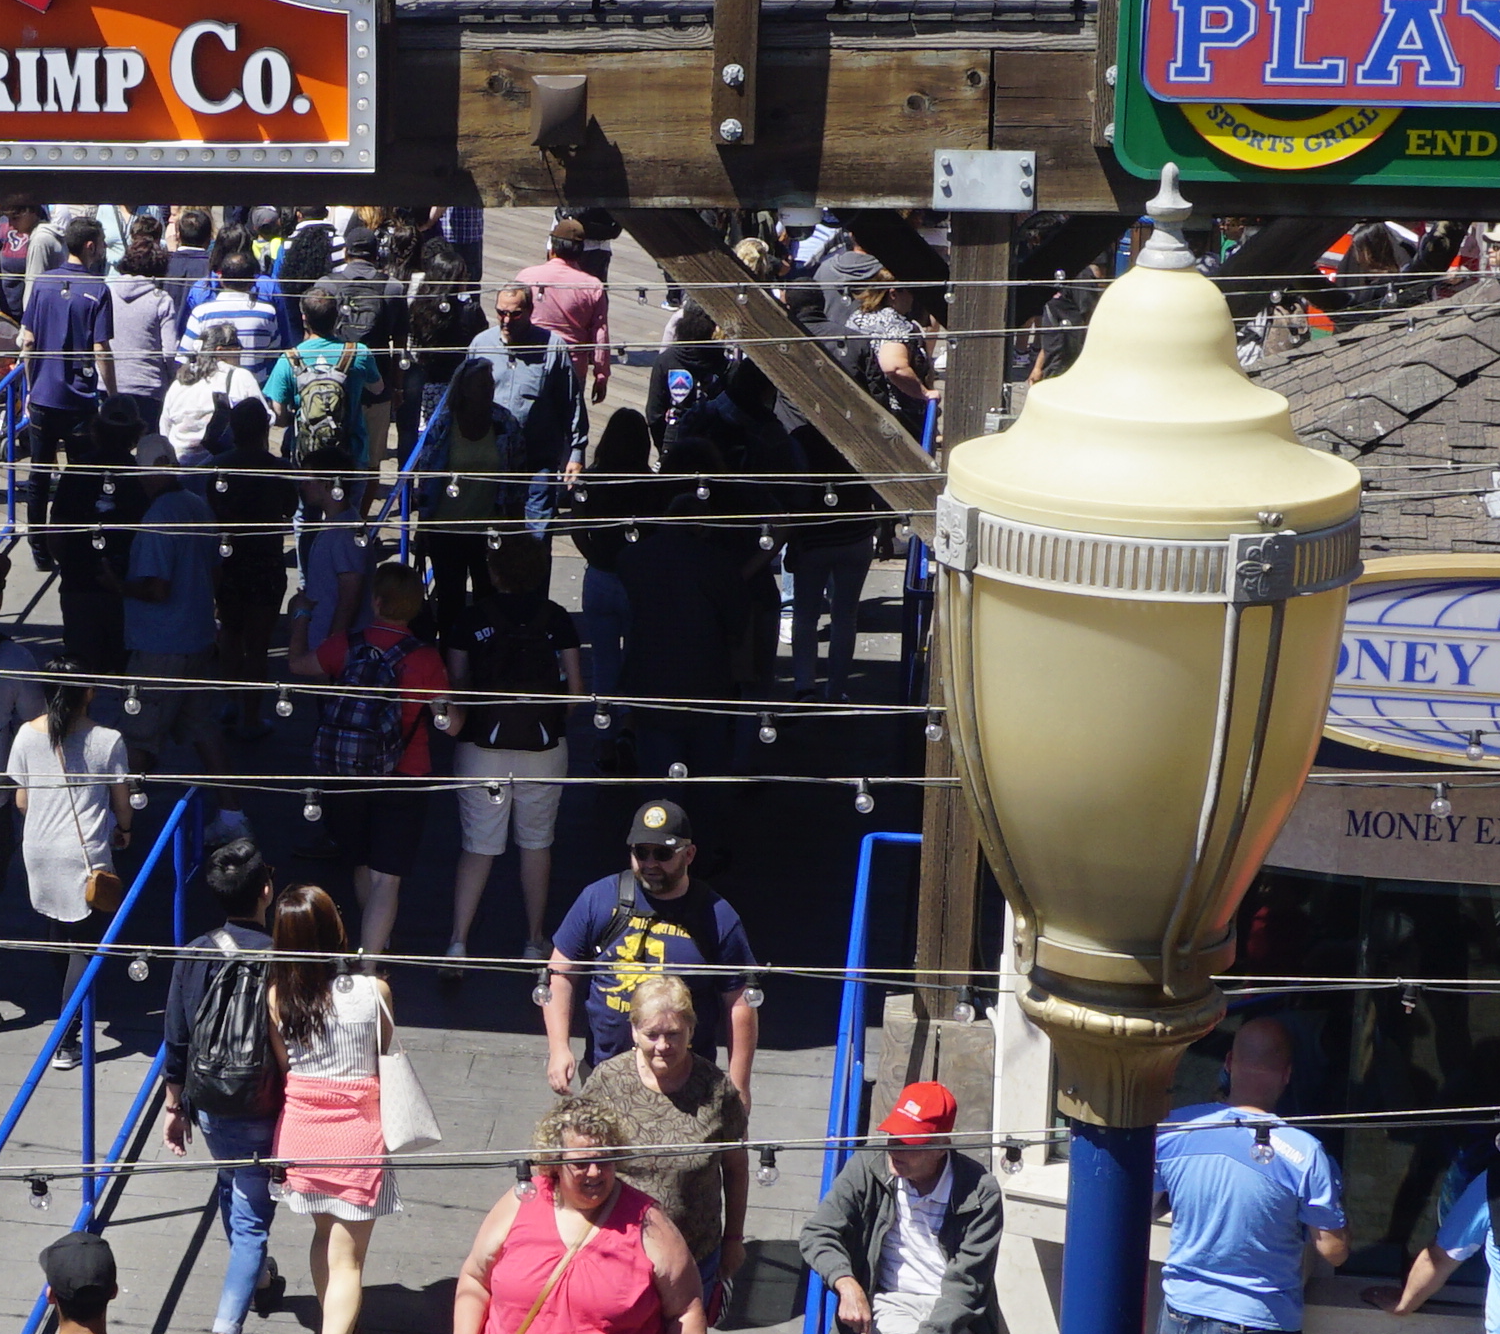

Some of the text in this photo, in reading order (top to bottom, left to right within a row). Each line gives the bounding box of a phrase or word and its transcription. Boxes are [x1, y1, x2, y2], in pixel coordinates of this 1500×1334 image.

[1205, 104, 1380, 154] SPORTS GRILL
[1405, 129, 1498, 160] END
[1335, 637, 1487, 688] NEY
[1345, 809, 1467, 843] MONEY
